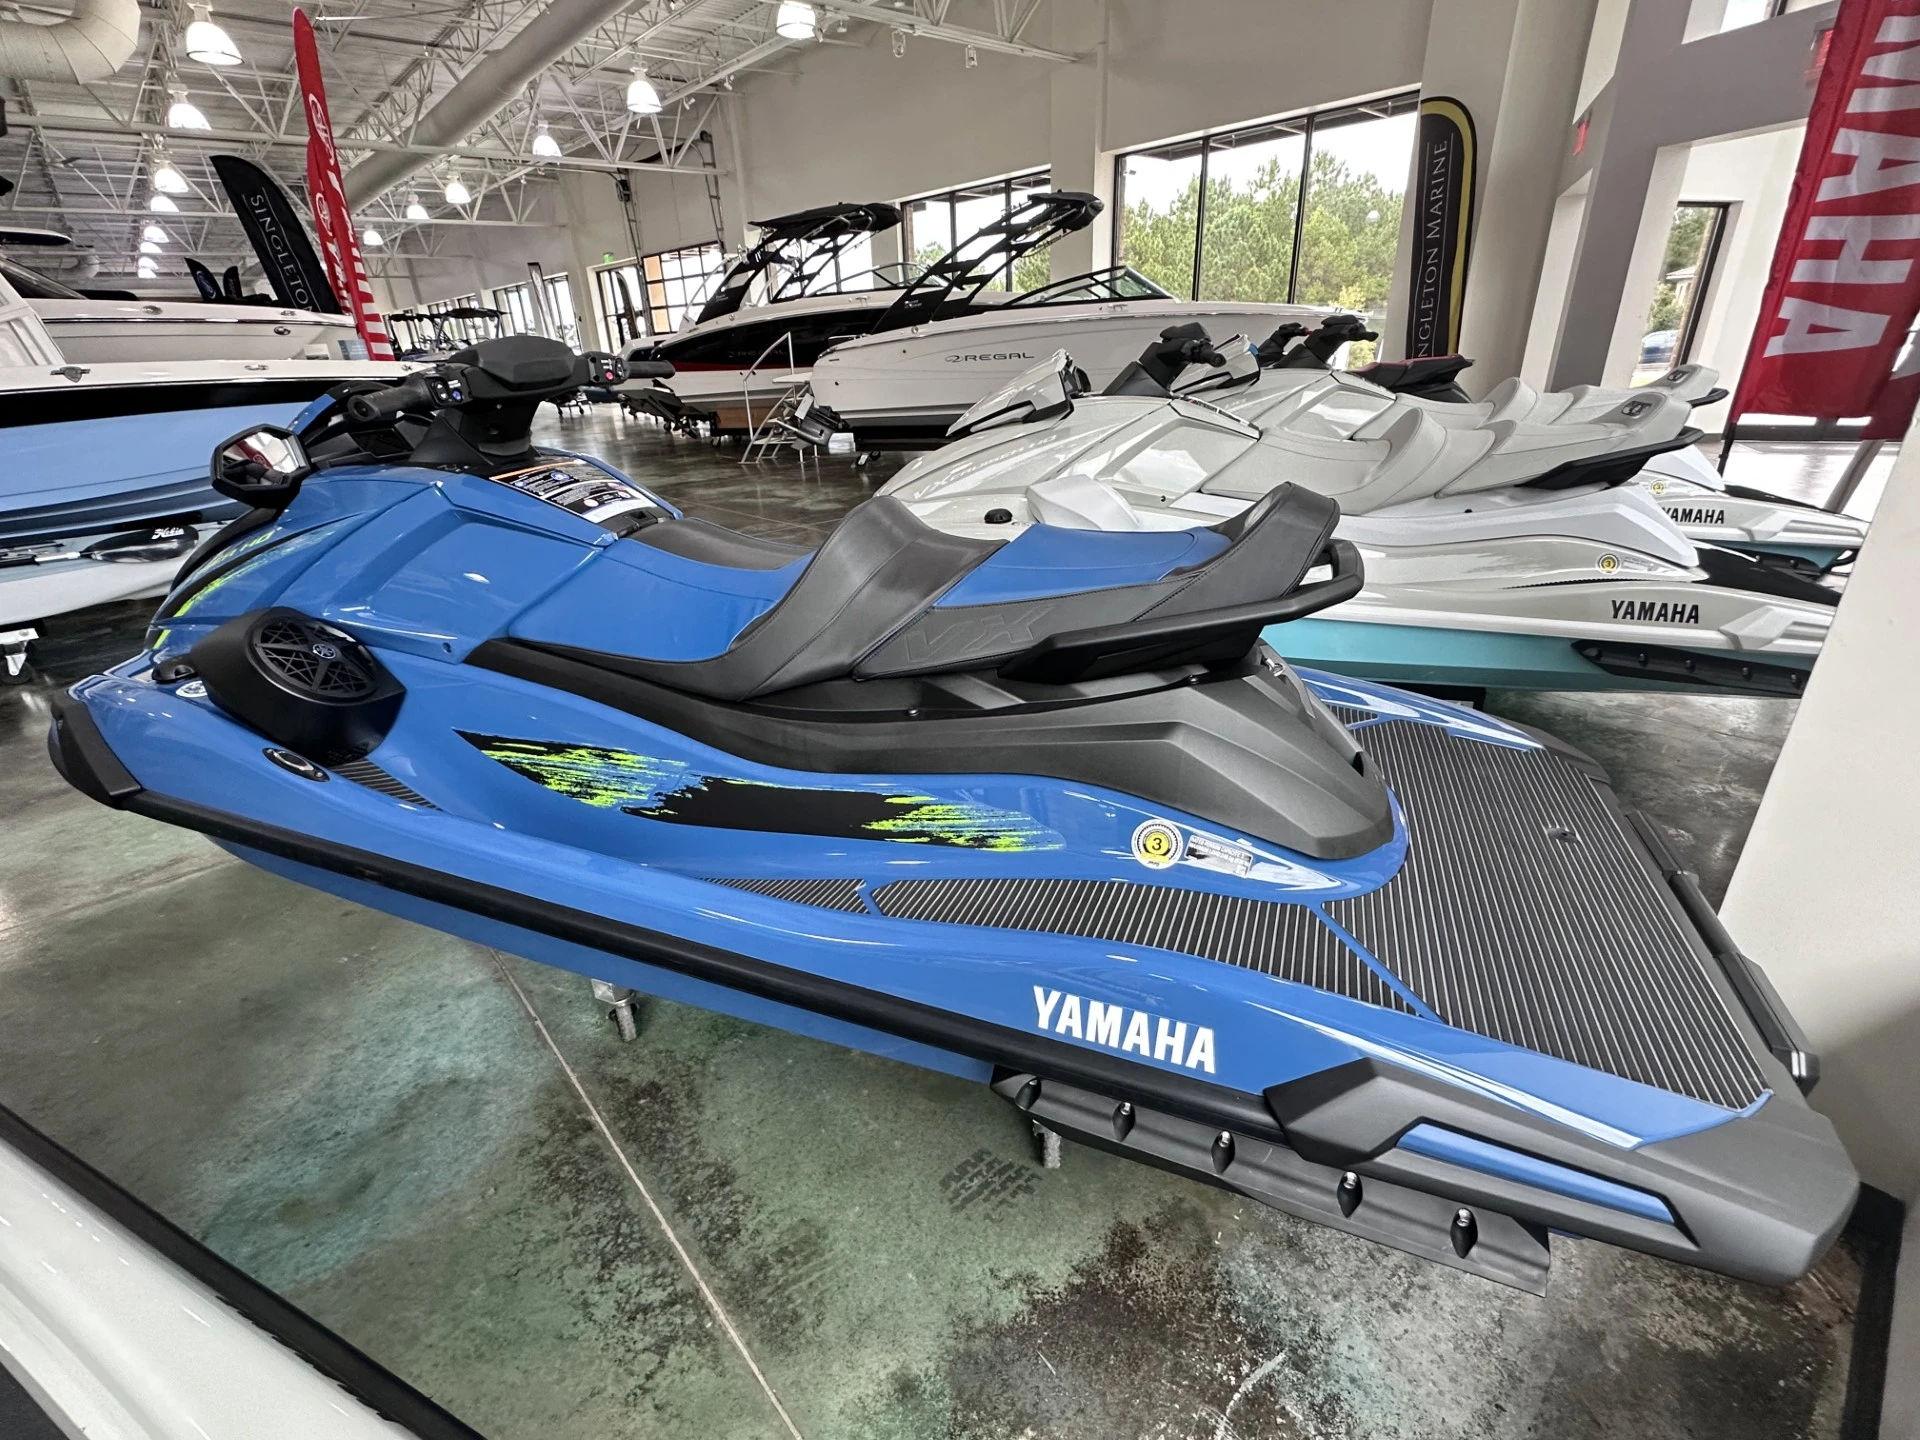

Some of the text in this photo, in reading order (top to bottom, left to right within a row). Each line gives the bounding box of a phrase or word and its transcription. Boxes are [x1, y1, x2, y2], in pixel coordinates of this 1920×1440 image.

[1763, 13, 1920, 358] MAHA
[251, 194, 313, 313] SINGLETO
[1418, 140, 1447, 358] NGLETON MARINE
[964, 352, 1035, 362] REGAL
[1611, 600, 1700, 624] YAMAHA
[1152, 837, 1162, 851] 3
[1033, 984, 1216, 1075] YAMAHA
